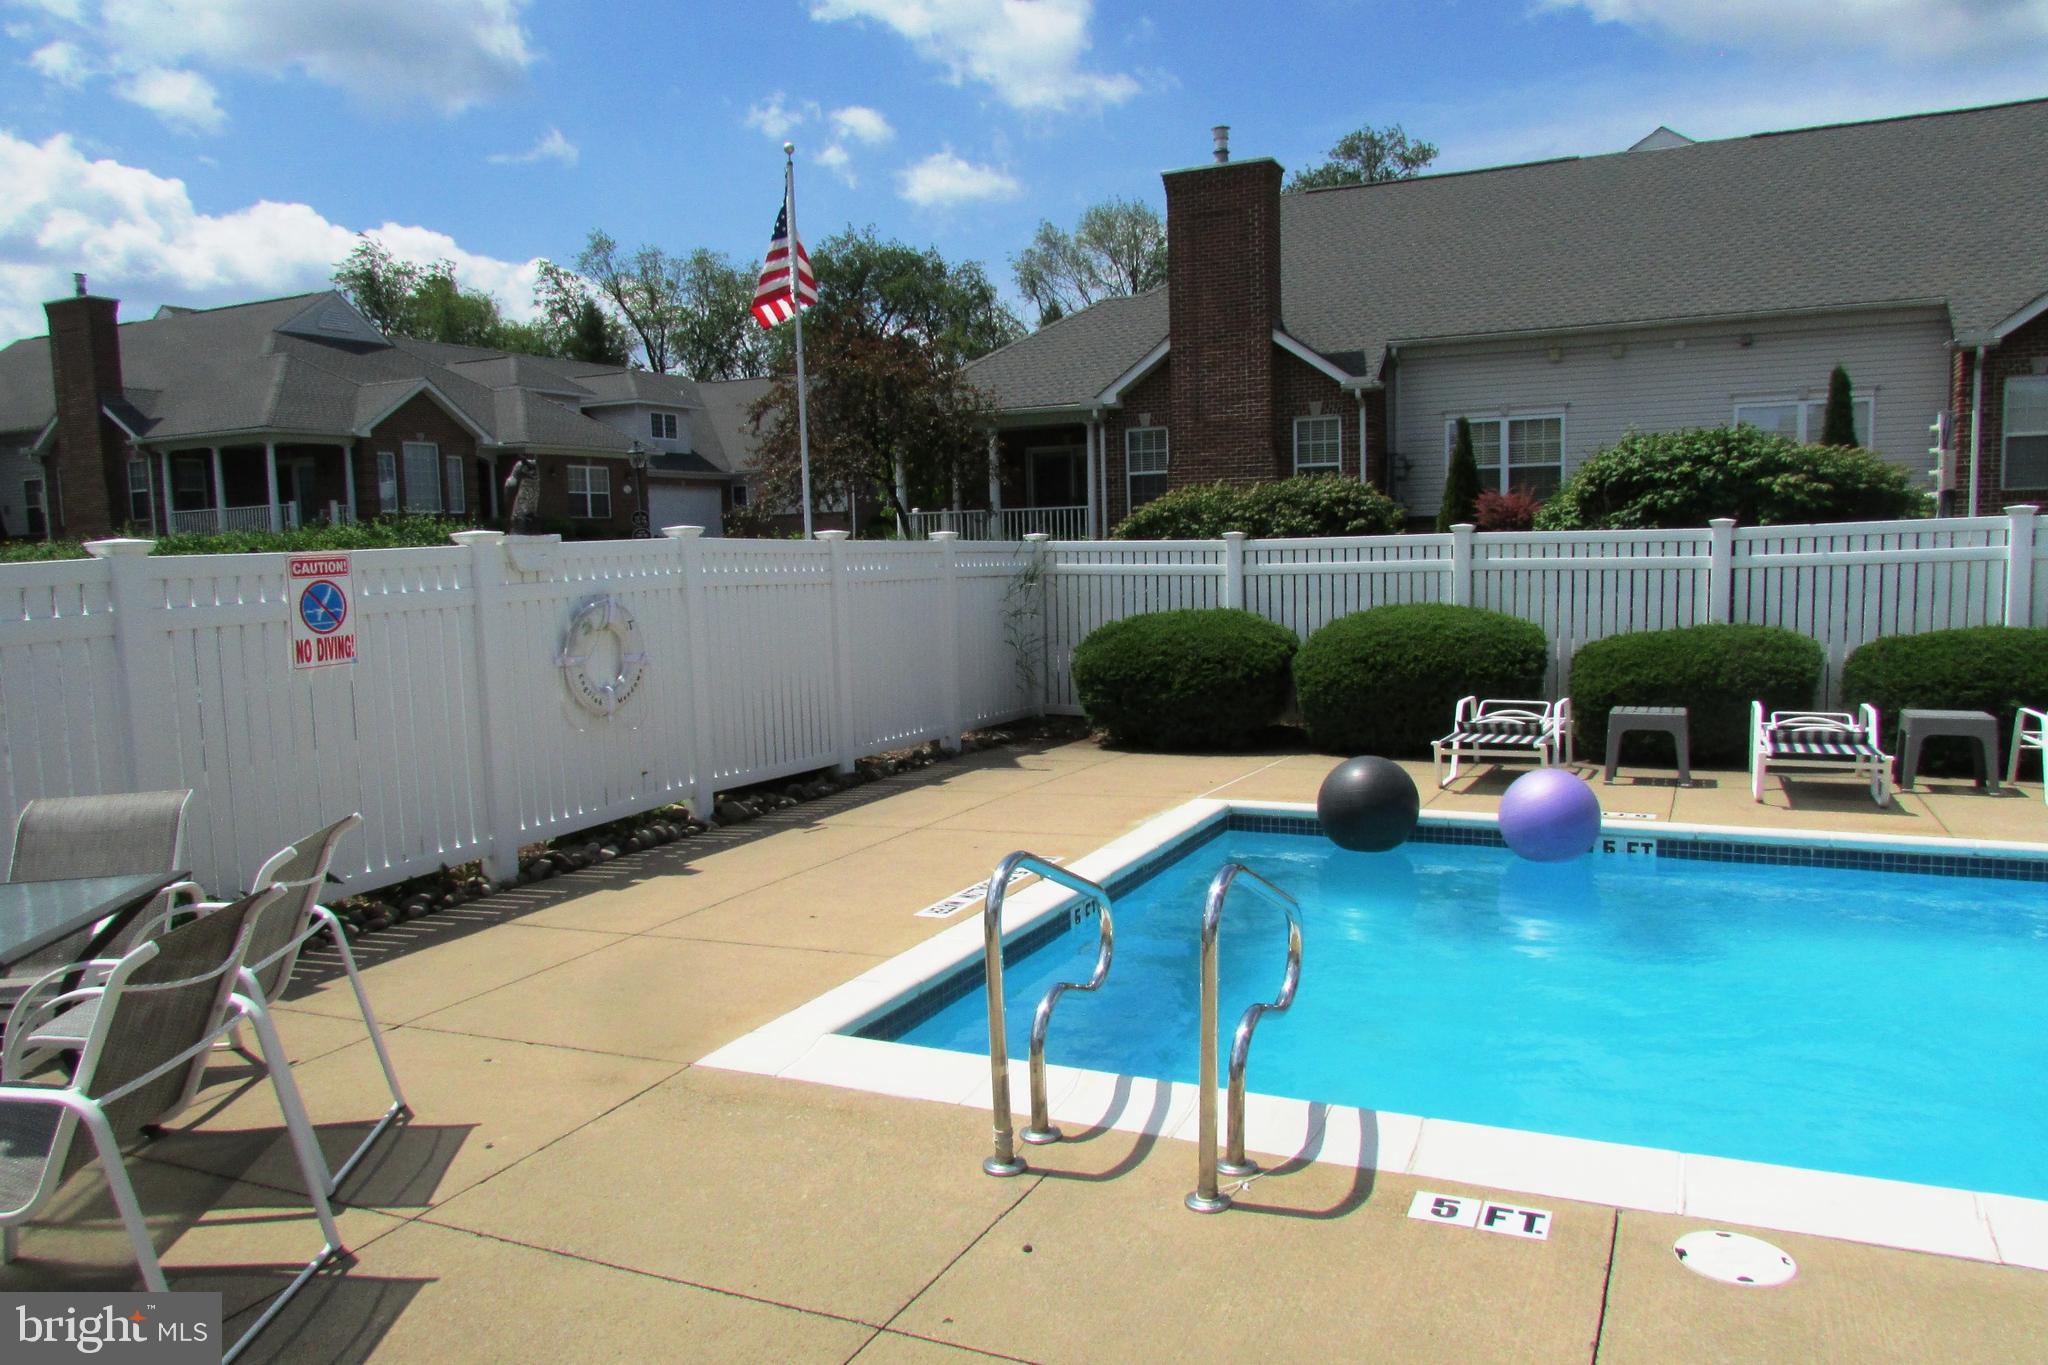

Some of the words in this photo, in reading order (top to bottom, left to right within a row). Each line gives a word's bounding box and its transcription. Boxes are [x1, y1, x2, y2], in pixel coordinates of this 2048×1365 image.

[292, 560, 348, 575] CAUTION!
[295, 639, 312, 664] NO
[317, 634, 355, 662] DIVING!
[1430, 1197, 1461, 1219] 5
